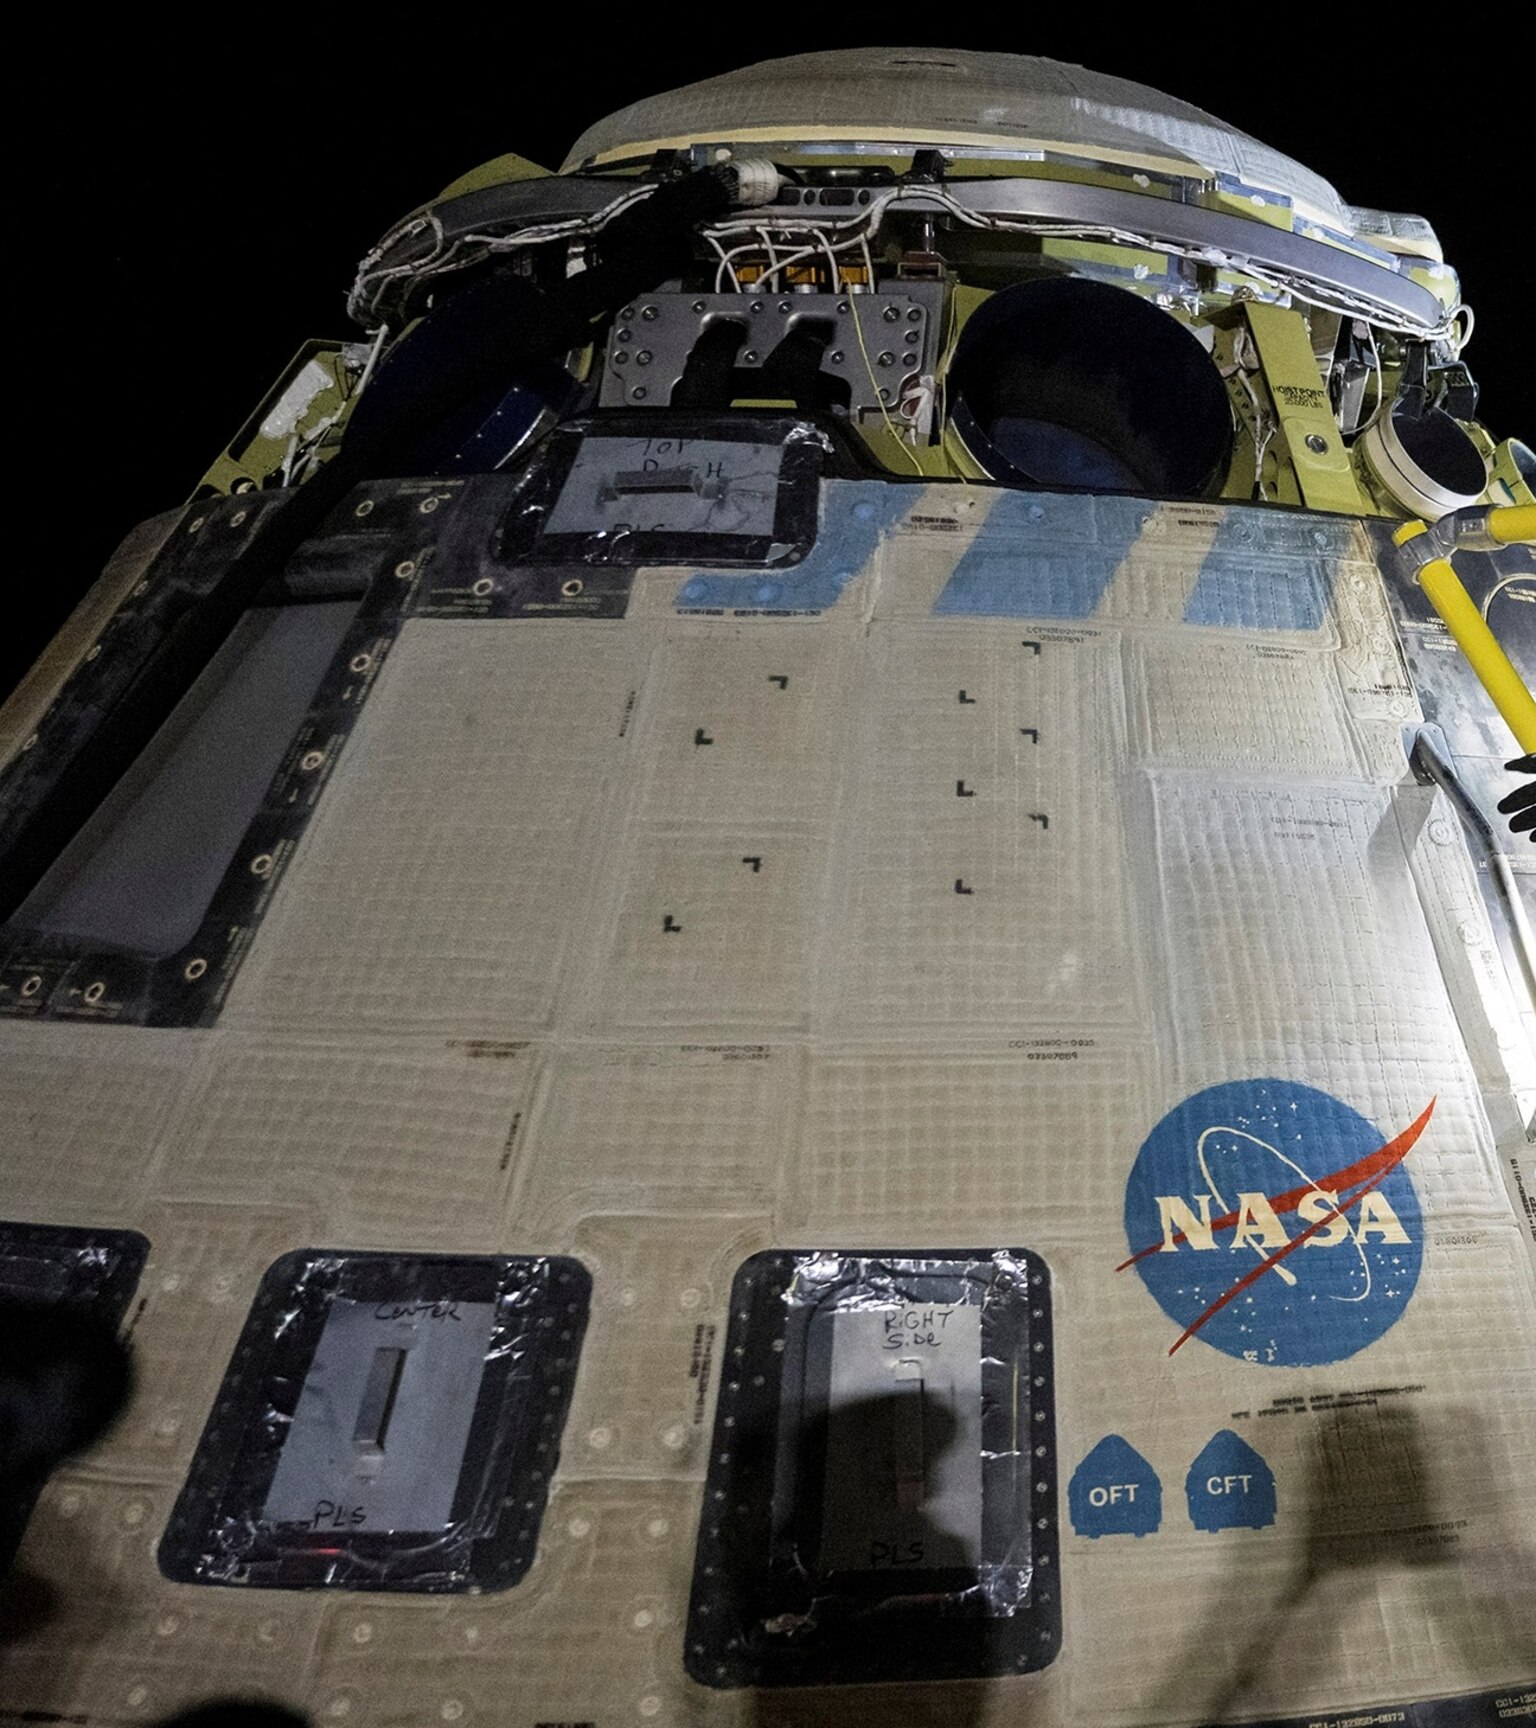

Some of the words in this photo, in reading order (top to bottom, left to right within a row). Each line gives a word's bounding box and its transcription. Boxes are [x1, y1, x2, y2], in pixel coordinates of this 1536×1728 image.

[1154, 1190, 1413, 1252] NASA
[1088, 1483, 1140, 1508] OFT
[1206, 1474, 1253, 1496] CFT
